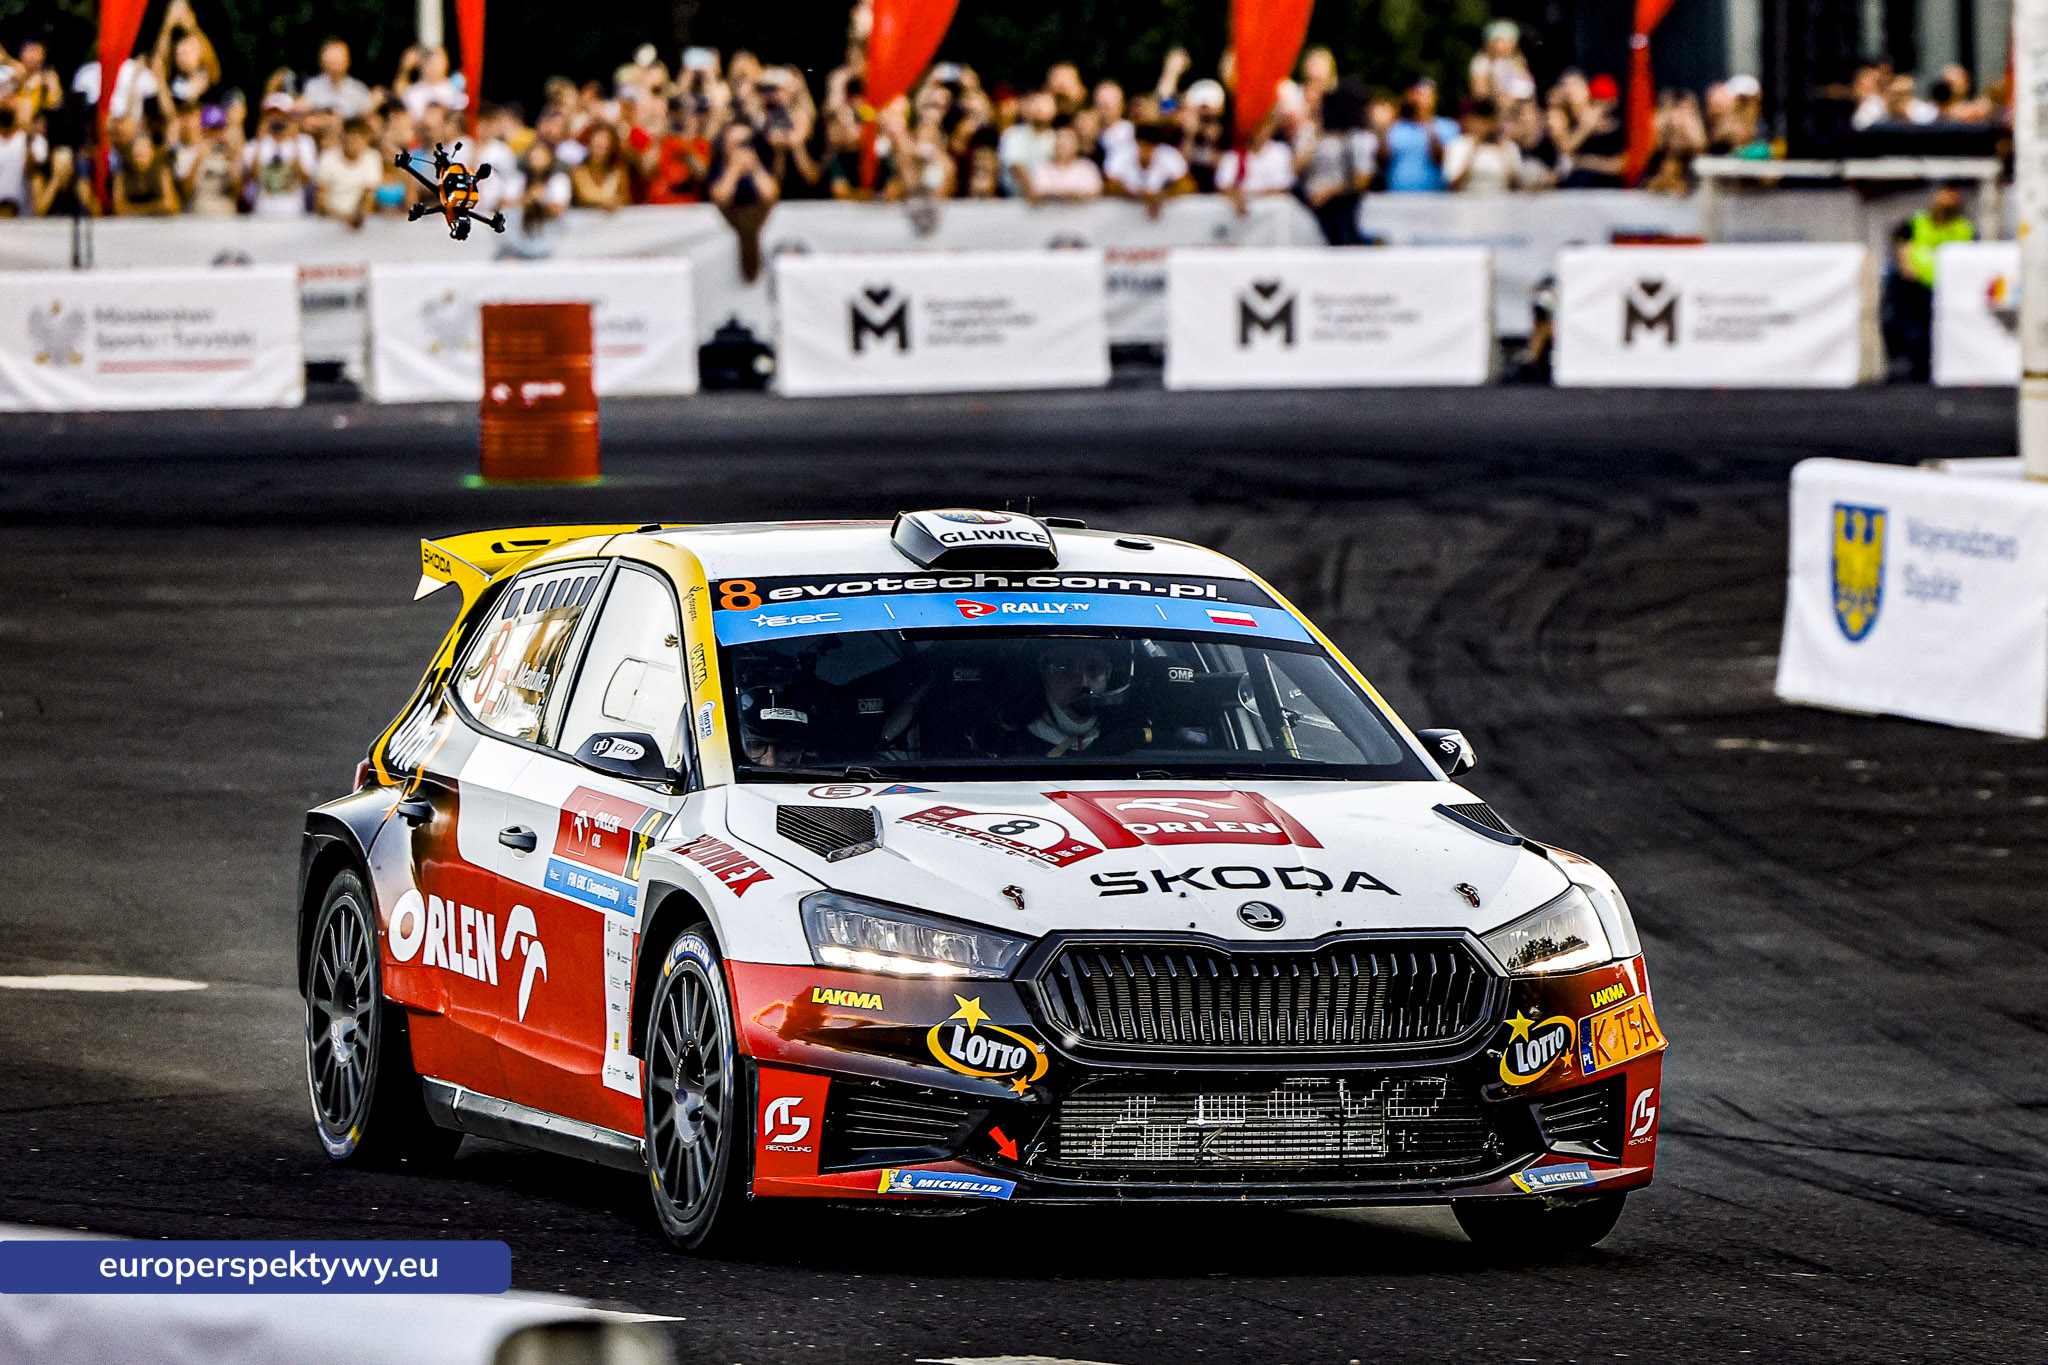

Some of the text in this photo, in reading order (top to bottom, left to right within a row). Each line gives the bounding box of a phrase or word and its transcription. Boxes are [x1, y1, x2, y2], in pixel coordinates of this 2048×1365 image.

[939, 529, 1048, 546] GLIWICE
[424, 548, 452, 576] SKODA
[719, 579, 762, 611] 8
[475, 621, 512, 703] 8
[1168, 669, 1194, 680] OMP
[988, 819, 1041, 836] 8
[1128, 818, 1283, 838] ORLEN
[909, 817, 1062, 864] RALLY POLAND
[1089, 865, 1401, 897] SKODA
[388, 889, 498, 986] ORLEN
[811, 987, 884, 1011] LAKMA
[1590, 982, 1628, 1009] LAKMA
[1582, 1052, 1594, 1067] PL
[765, 1144, 813, 1153] RECYCLING
[915, 1177, 1003, 1194] MICHELIN
[1540, 1171, 1588, 1183] MICHELIN
